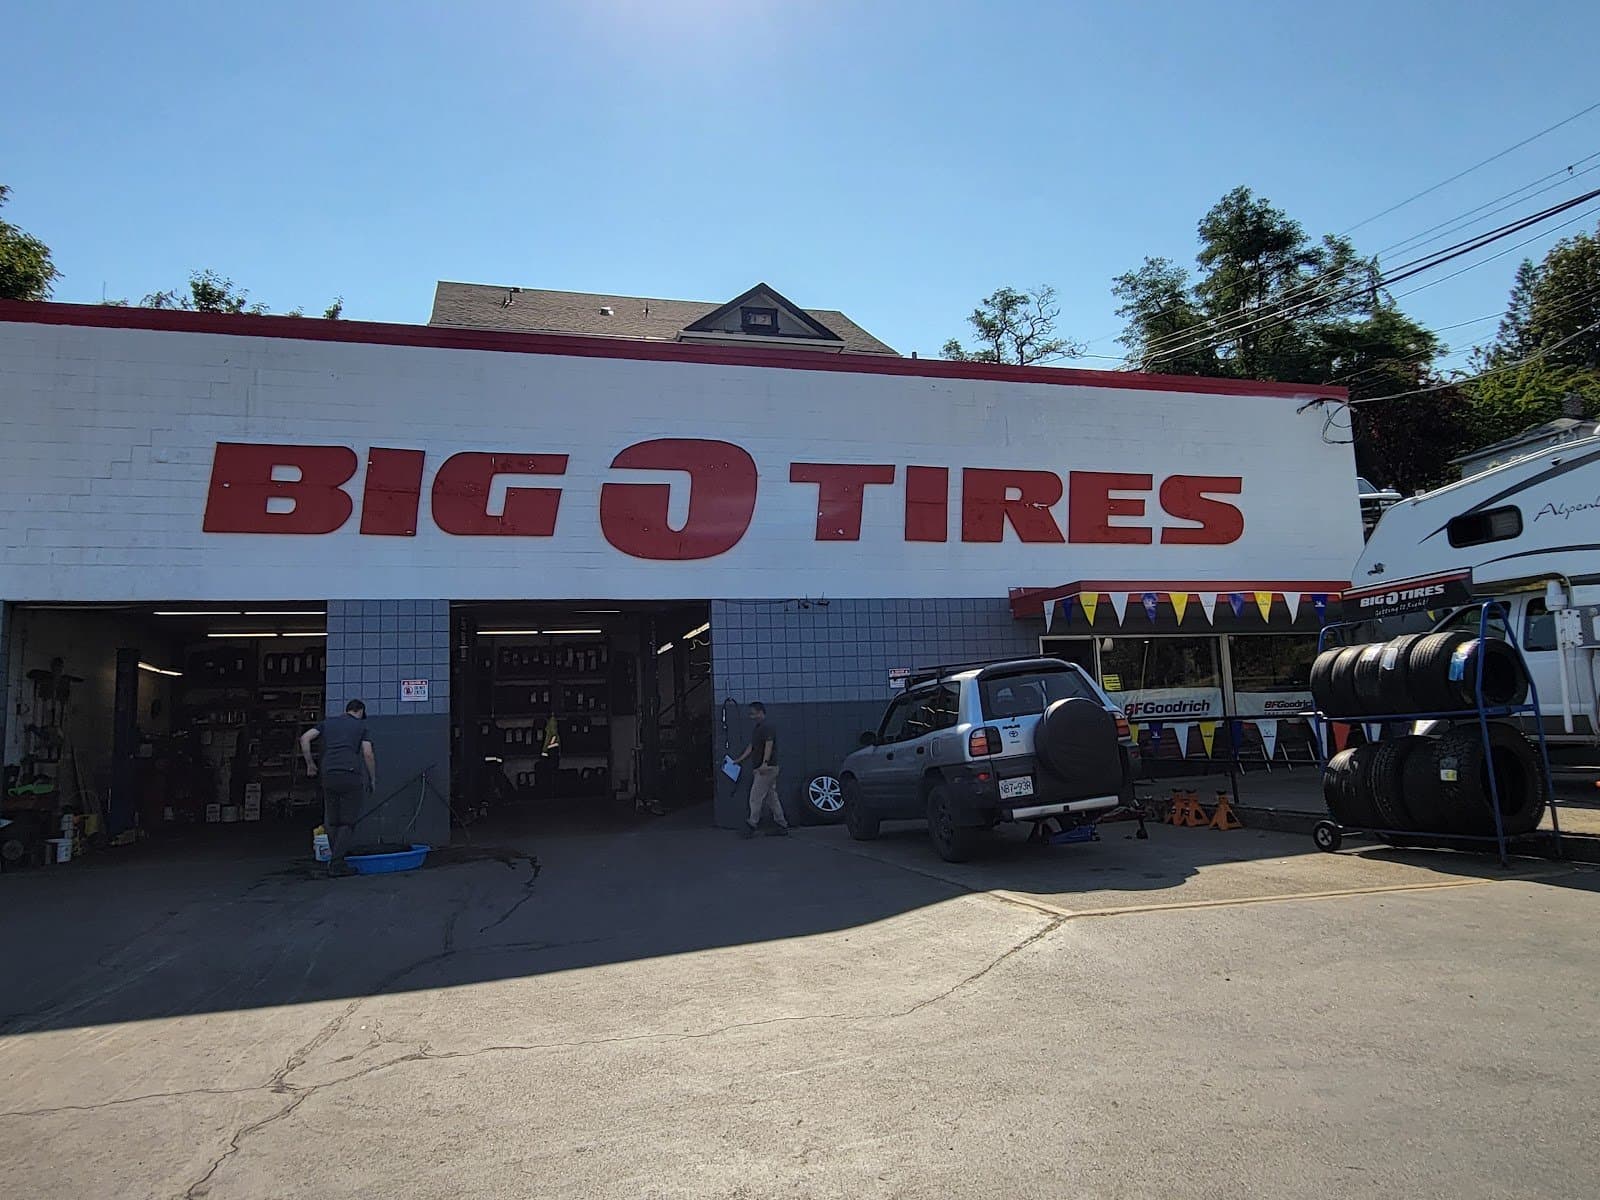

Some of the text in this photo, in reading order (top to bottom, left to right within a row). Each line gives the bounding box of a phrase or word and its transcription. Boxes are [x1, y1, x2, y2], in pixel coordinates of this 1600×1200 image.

[203, 438, 1245, 561] BIG O TIRES
[1360, 584, 1445, 607] BIG O TIRES
[1124, 699, 1210, 715] BFGoodrich
